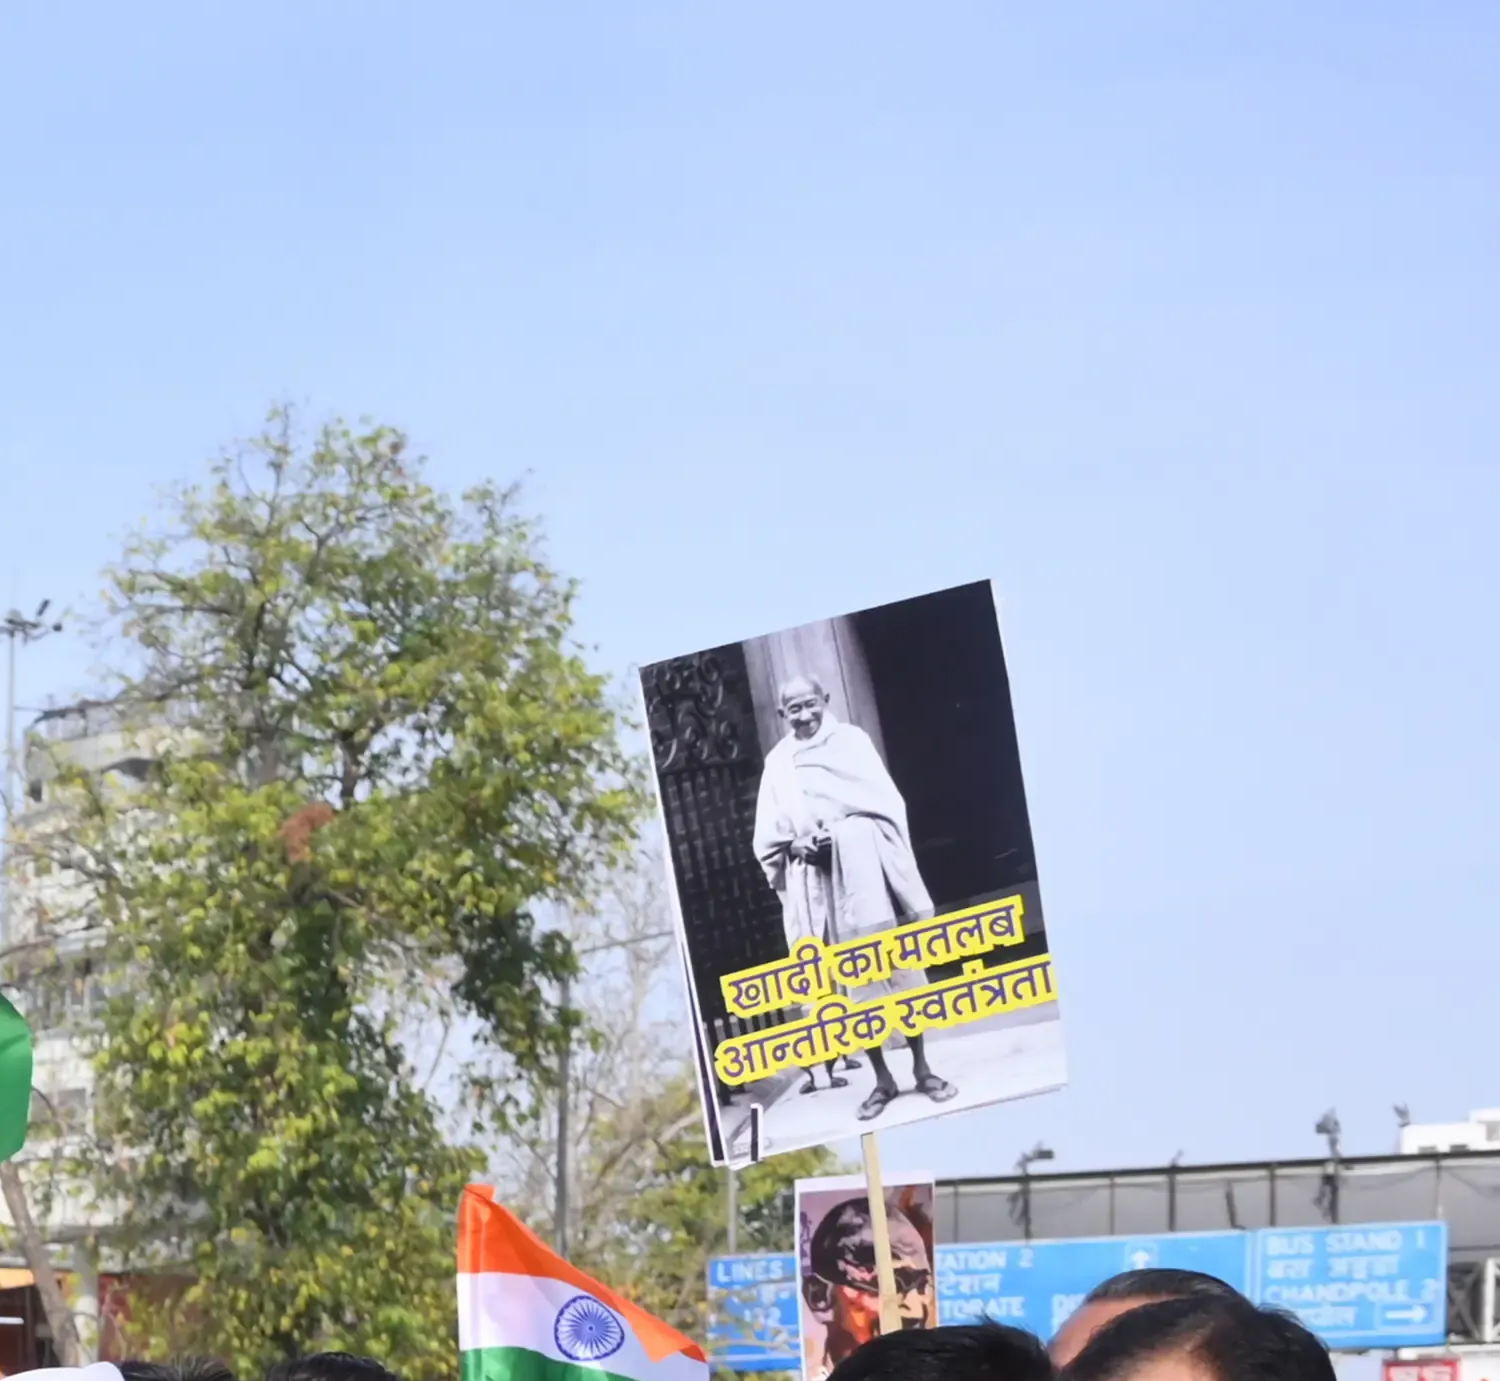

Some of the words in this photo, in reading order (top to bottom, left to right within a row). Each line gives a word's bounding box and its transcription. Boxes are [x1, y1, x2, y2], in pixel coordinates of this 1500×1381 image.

[729, 944, 823, 1009] खादी
[834, 939, 885, 980] का
[894, 905, 1016, 964] मतलब
[722, 1003, 886, 1078] आन्तरिक
[896, 962, 1052, 1029] स्वतंत्रता
[1267, 1233, 1314, 1256] BUS
[1325, 1229, 1402, 1253] STAND
[716, 1259, 783, 1283] LINES
[936, 1249, 1006, 1270] TATION
[1019, 1248, 1034, 1268] 2
[938, 1271, 1003, 1297] टेशन
[1266, 1278, 1410, 1303] CHANDPOLE
[942, 1296, 1025, 1318] TORATE
